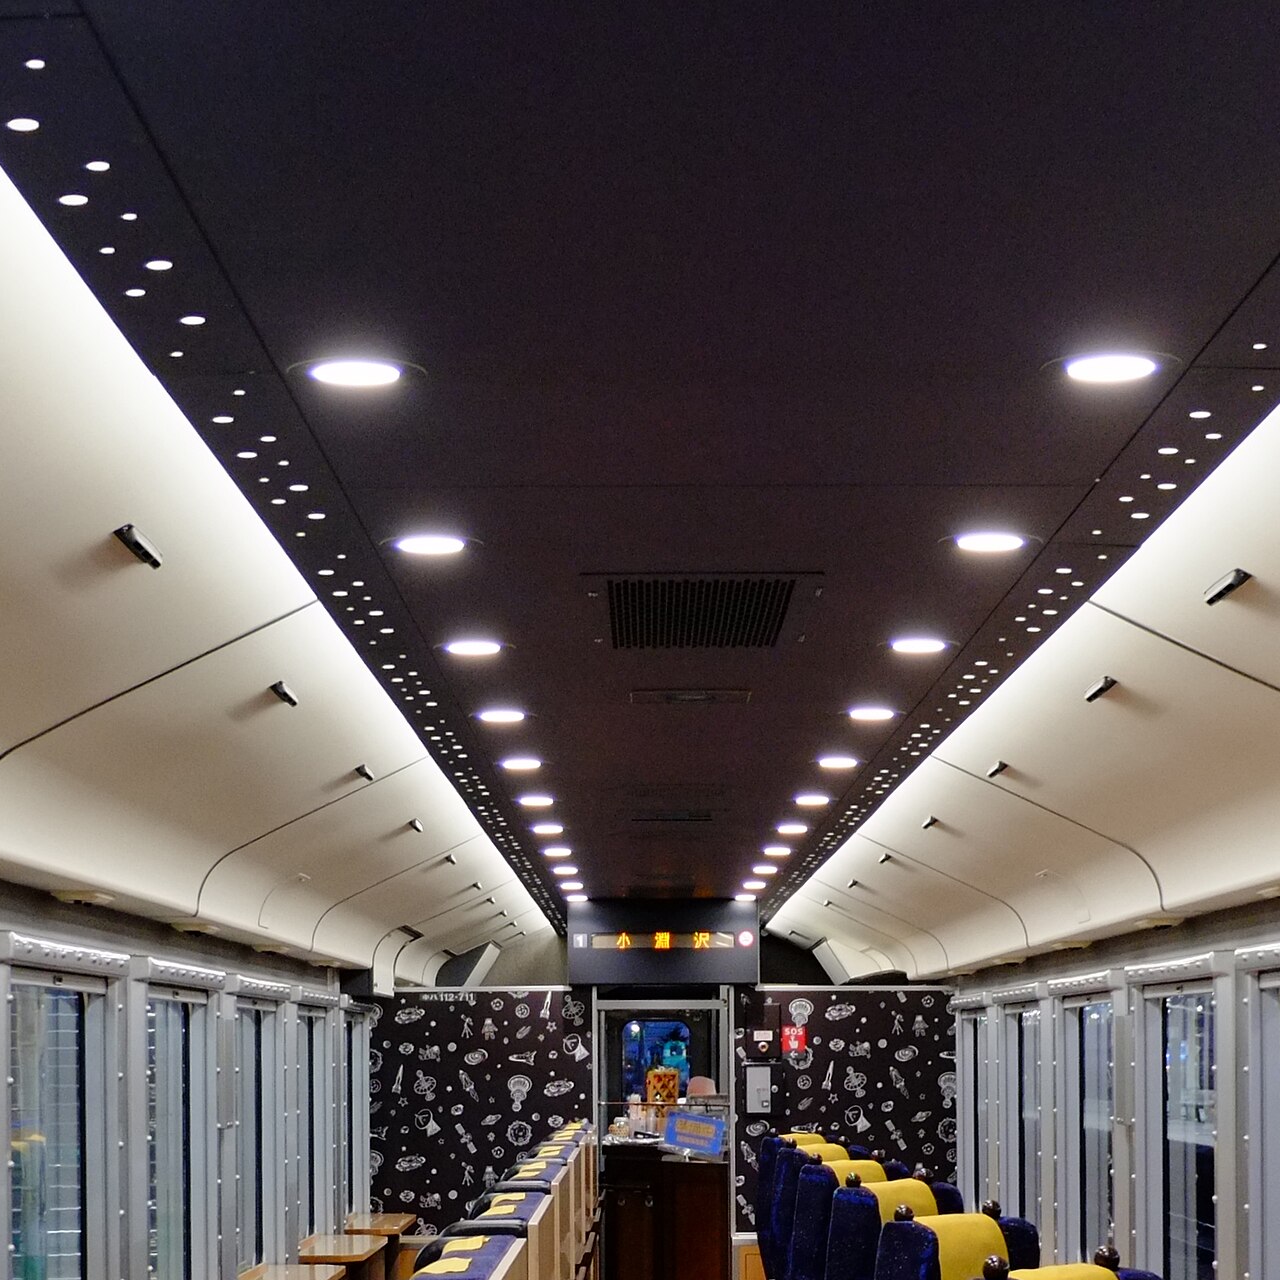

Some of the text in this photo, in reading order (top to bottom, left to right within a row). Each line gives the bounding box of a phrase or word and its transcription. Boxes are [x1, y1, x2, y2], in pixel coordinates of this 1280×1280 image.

[616, 932, 710, 949] 小淵沢
[785, 1027, 803, 1036] SOS
